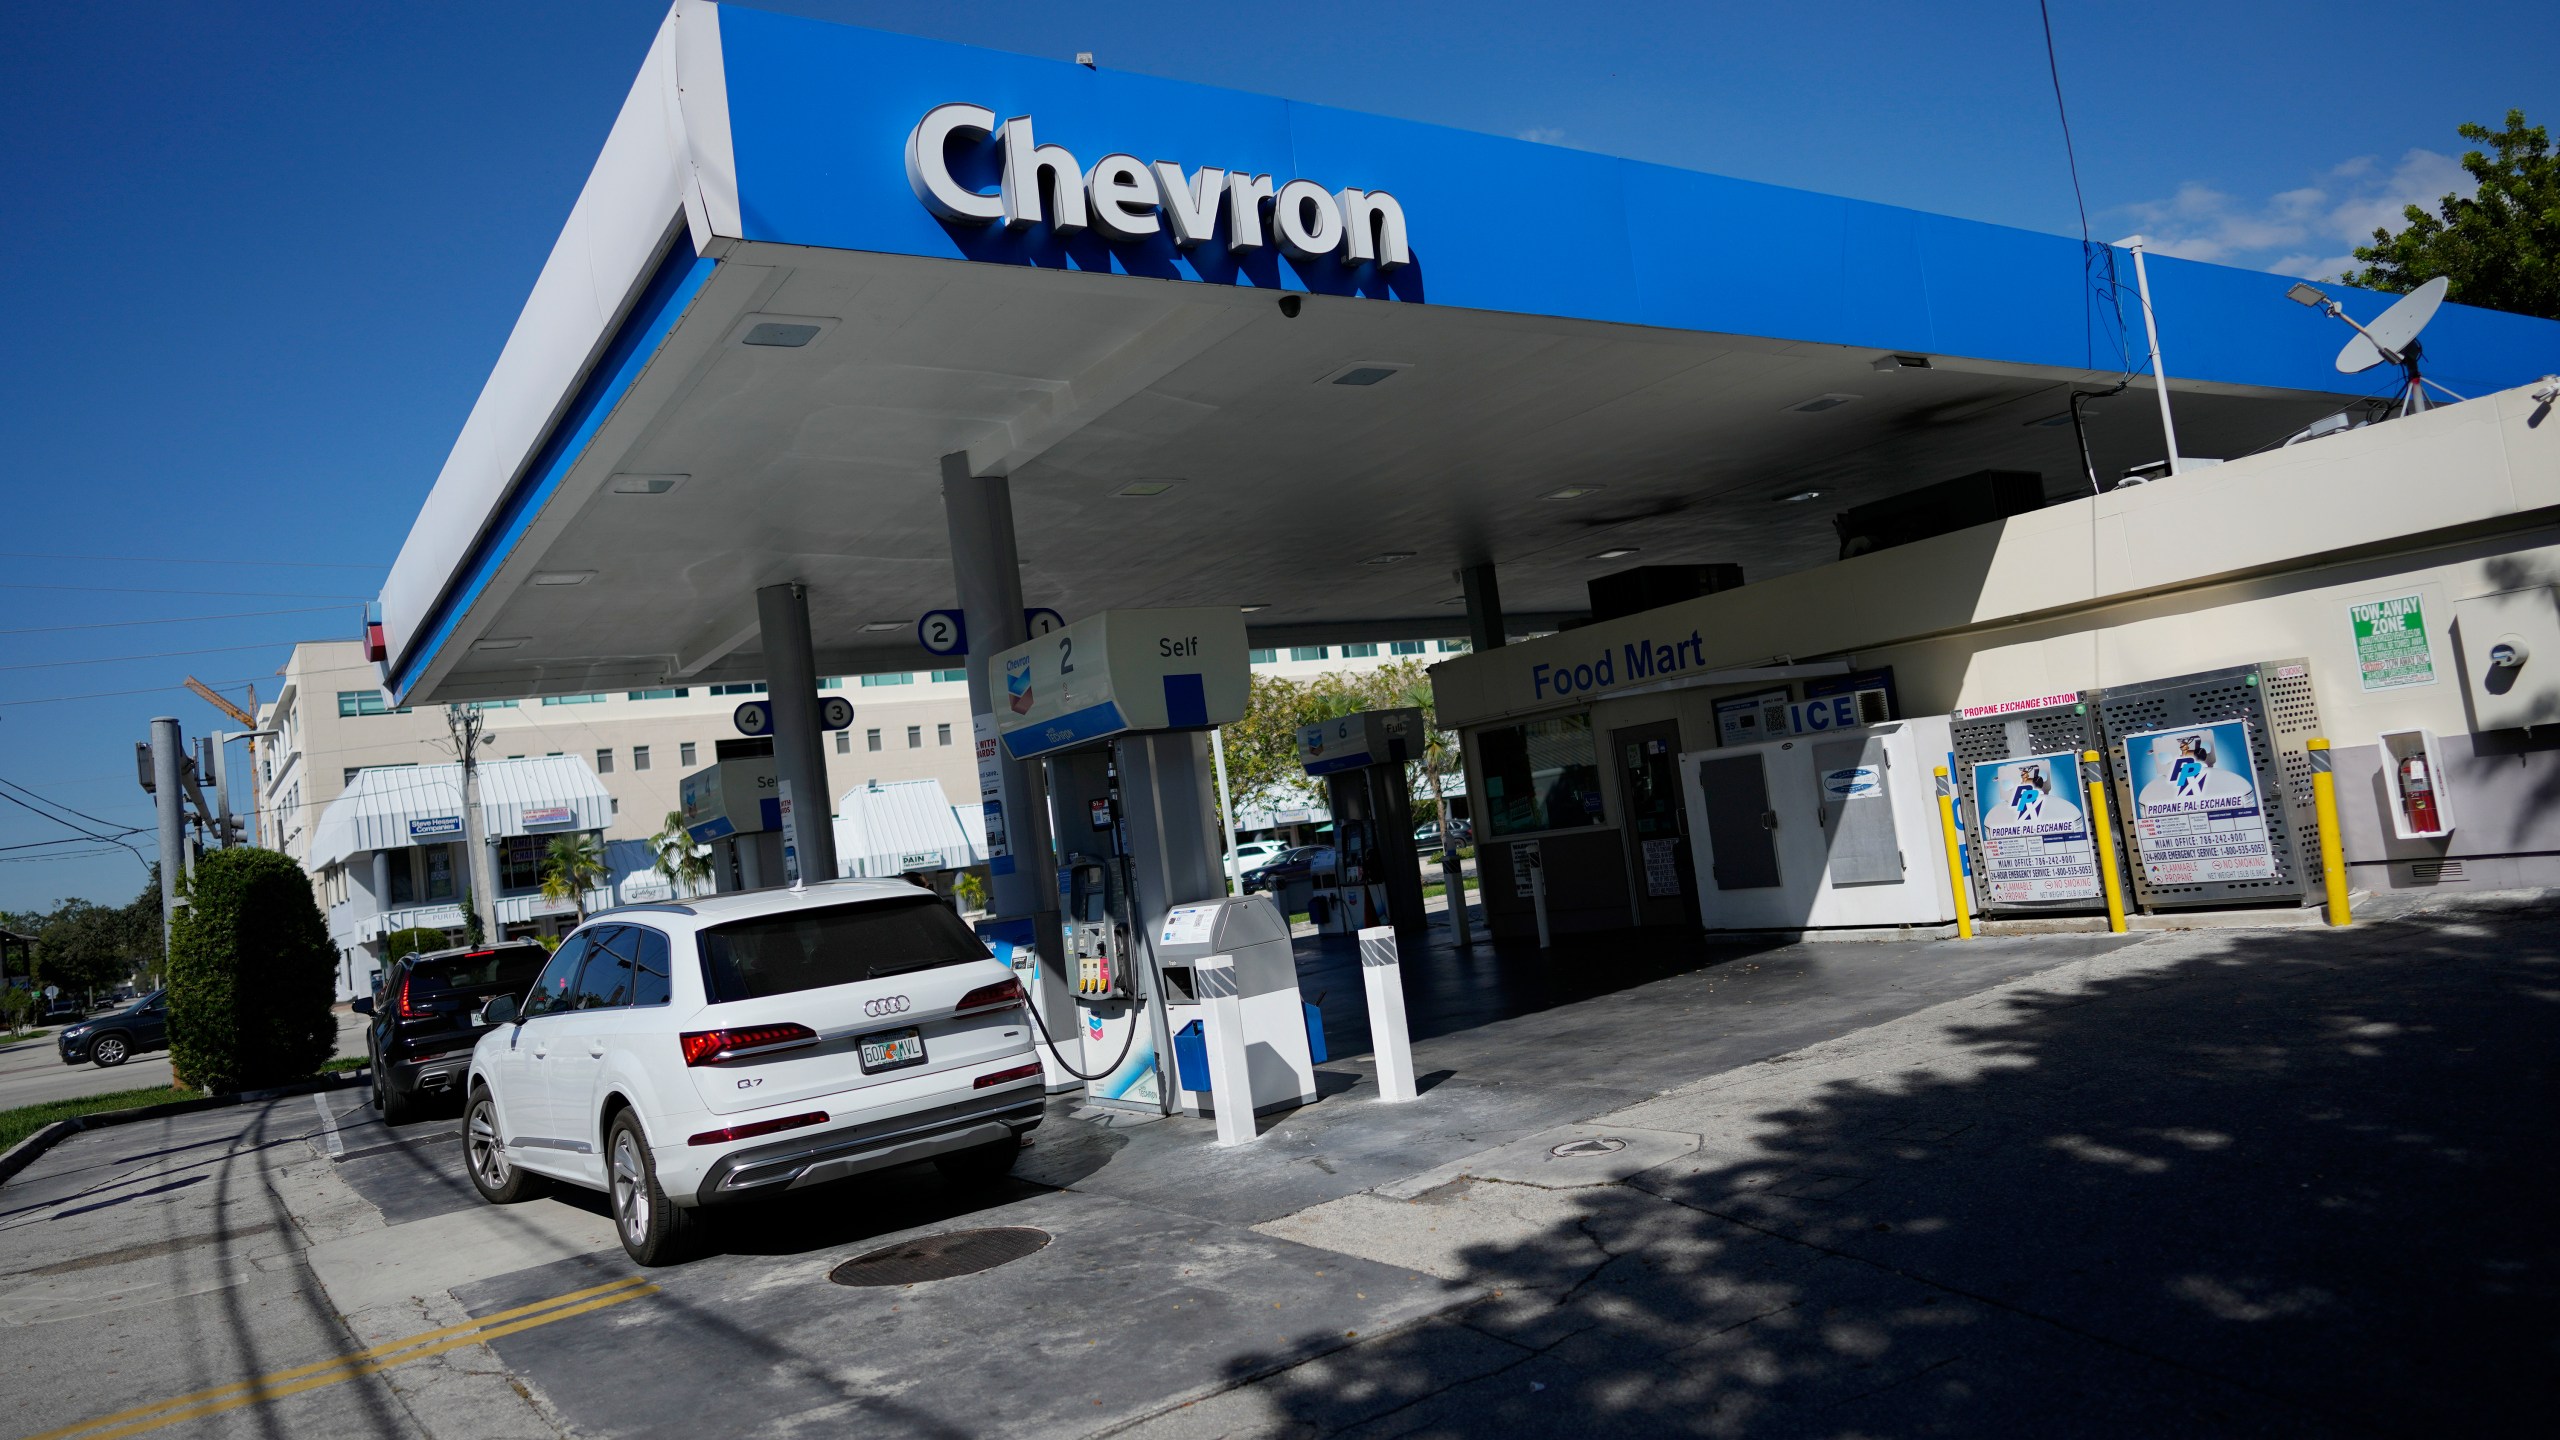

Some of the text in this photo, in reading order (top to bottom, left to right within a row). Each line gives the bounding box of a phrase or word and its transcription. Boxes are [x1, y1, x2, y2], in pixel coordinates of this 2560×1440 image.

[905, 102, 1409, 271] Chevron
[2352, 597, 2419, 622] TOW-AWAY
[932, 622, 948, 642] 2
[2370, 615, 2406, 634] ZONE
[1160, 636, 1197, 657] Self
[1007, 656, 1029, 671] Chevron
[1059, 638, 1073, 675] 2
[2384, 658, 2399, 668] TOW
[1533, 630, 1706, 699] Food Mart
[832, 705, 843, 720] 3
[1964, 693, 2076, 717] PROPANE EXCHANGE STATION
[745, 711, 758, 726] 4
[1791, 697, 1854, 733] ICE
[1339, 723, 1347, 738] 6
[1387, 724, 1402, 733] Full
[980, 739, 996, 749] WITH
[758, 776, 778, 788] Sel
[2149, 797, 2241, 814] PROPANE PAL EXCHANGE
[1993, 822, 2072, 836] PROPANE PAL EXCHANGE
[2155, 833, 2246, 848] MIAMI OFFICE: 786-242-9001
[2146, 844, 2265, 861] 24-HOUR EMERGENCY SERVICE: 1-800-535-5053
[1998, 856, 2076, 868] MIAMI OFFICE: 786-242-9001
[2162, 857, 2265, 872] FLAMMABLE NO SMOKING
[1991, 866, 2091, 880] 24-HOUR EMERGENCY SERVICE: 1-800-535-5053
[2165, 873, 2193, 882] PROPANE
[2219, 871, 2236, 879] WEIGHT
[2004, 878, 2091, 891] FLAMMABLE NO SMOKING
[2005, 892, 2028, 900] PROPANE
[898, 1039, 919, 1056] MVL
[737, 1078, 762, 1090] Q7
